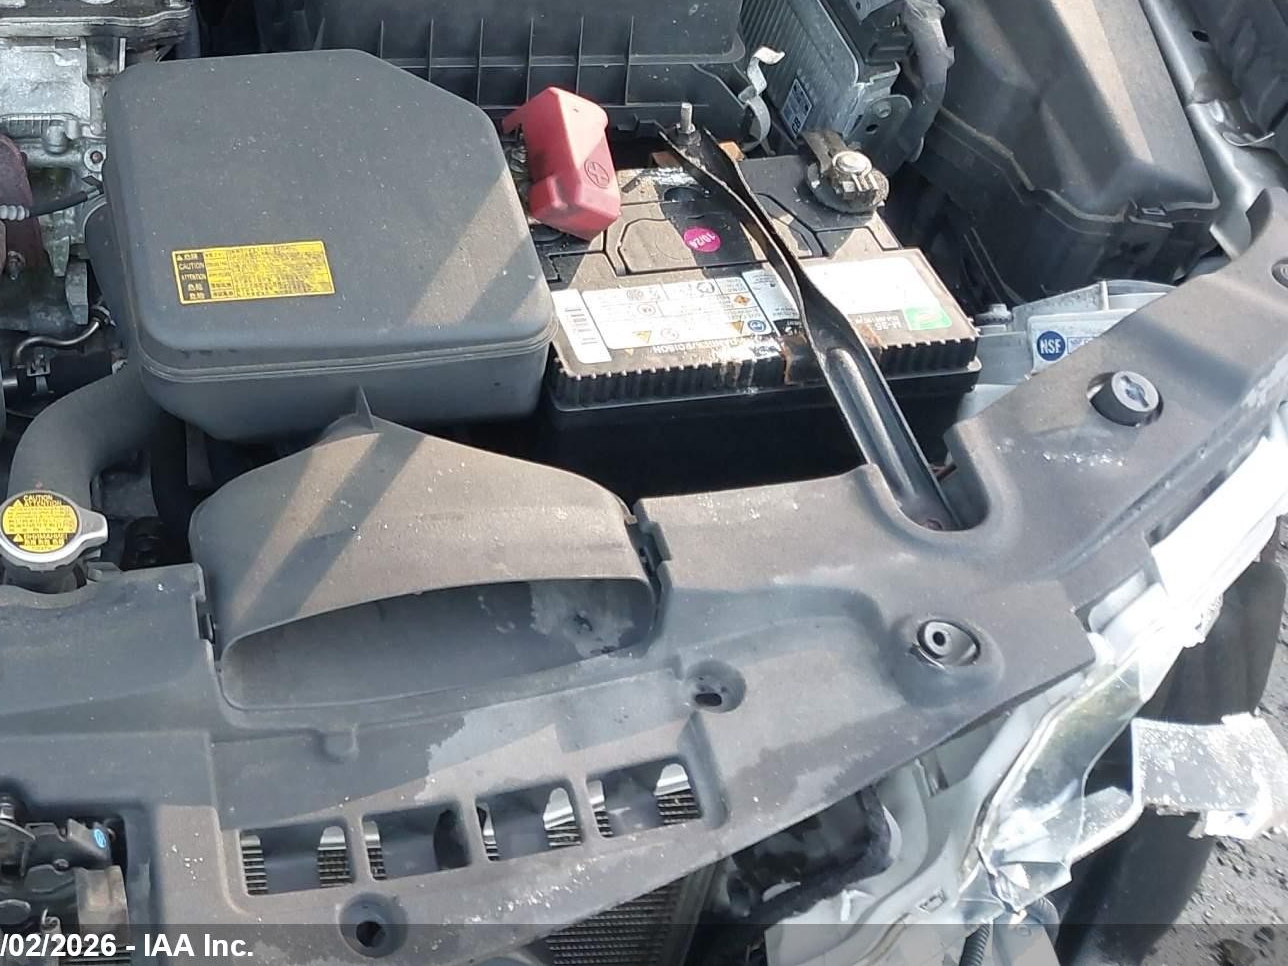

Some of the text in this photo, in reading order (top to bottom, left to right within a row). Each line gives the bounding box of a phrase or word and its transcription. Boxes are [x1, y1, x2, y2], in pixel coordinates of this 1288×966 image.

[178, 262, 205, 271] CAUTION
[1040, 338, 1062, 354] NSF
[23, 494, 53, 502] CAUTION
